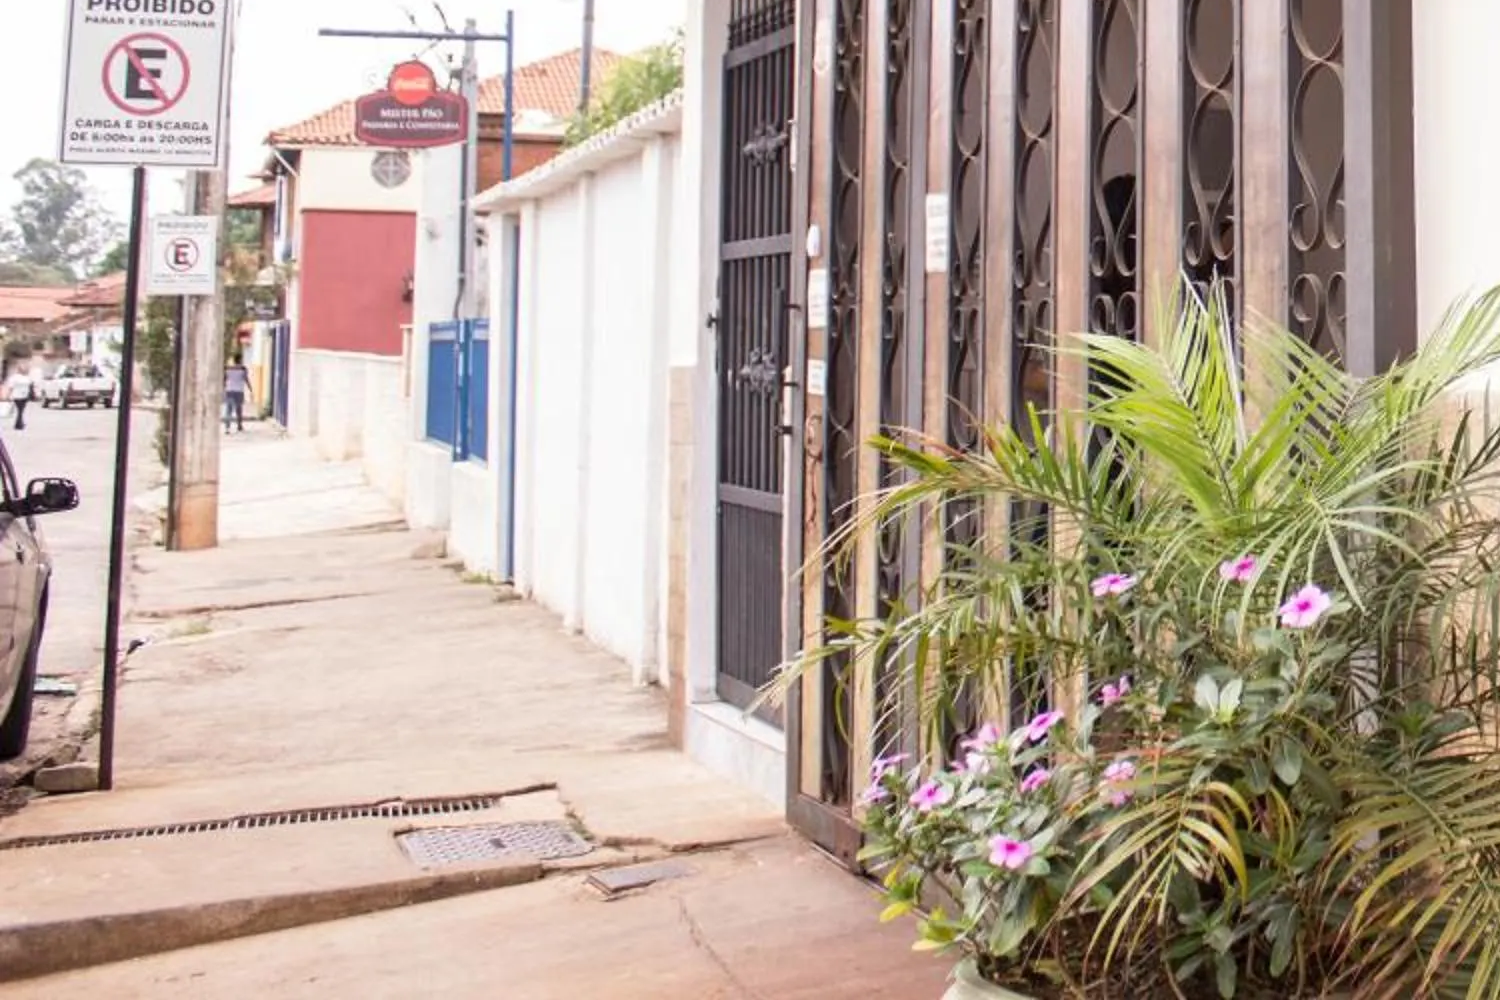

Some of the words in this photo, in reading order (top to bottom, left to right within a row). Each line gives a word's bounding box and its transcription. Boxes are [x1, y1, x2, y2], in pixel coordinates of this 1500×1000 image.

[85, 16, 125, 25] PARAR
[139, 18, 216, 28] ESTACIONAR
[125, 48, 167, 99] E
[75, 118, 121, 129] CARGA
[125, 119, 133, 129] E
[137, 119, 209, 131] DESCARGA
[70, 131, 87, 141] DE
